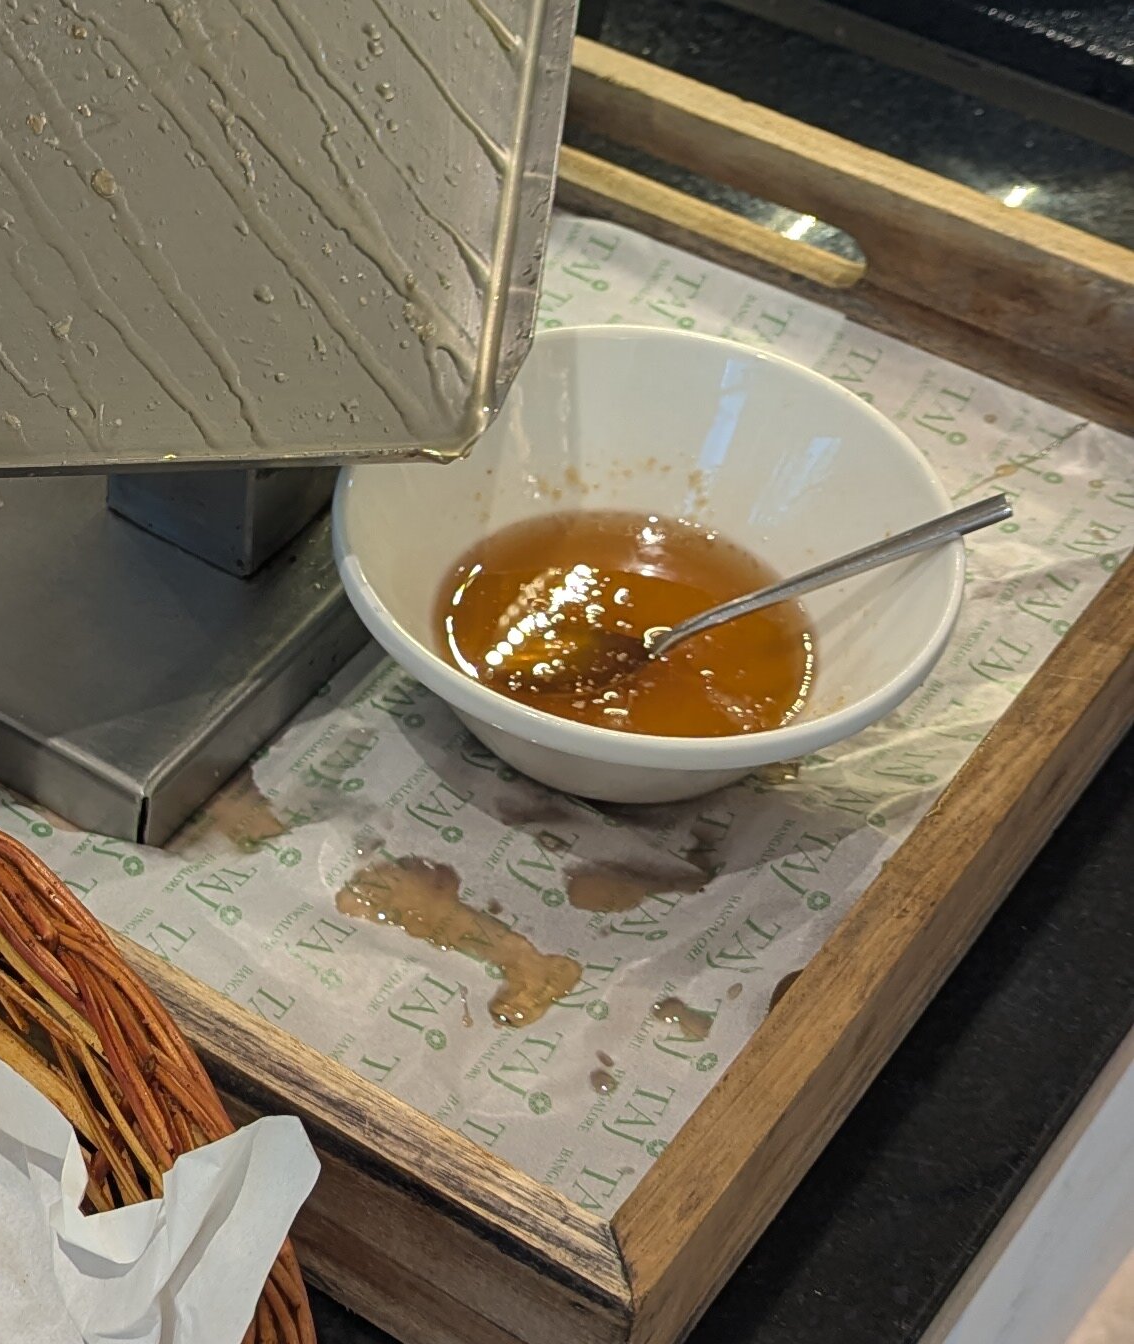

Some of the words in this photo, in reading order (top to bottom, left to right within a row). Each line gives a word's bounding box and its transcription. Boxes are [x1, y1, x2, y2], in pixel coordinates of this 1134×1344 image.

[968, 636, 1033, 684] TAJ
[406, 781, 475, 830] TAJ
[185, 866, 258, 912] TAJ
[506, 829, 580, 893] TAJ
[770, 831, 846, 898] TAJ
[610, 892, 684, 937] TAJ
[686, 894, 742, 963] BANGALORE
[285, 918, 358, 974] TAJ
[706, 914, 783, 973] TAJ
[388, 973, 463, 1033] TAJ
[488, 1031, 564, 1098] TAJ
[602, 1085, 677, 1147] TAJ
[542, 1147, 574, 1186] BANGA
[573, 1165, 626, 1210] TA
